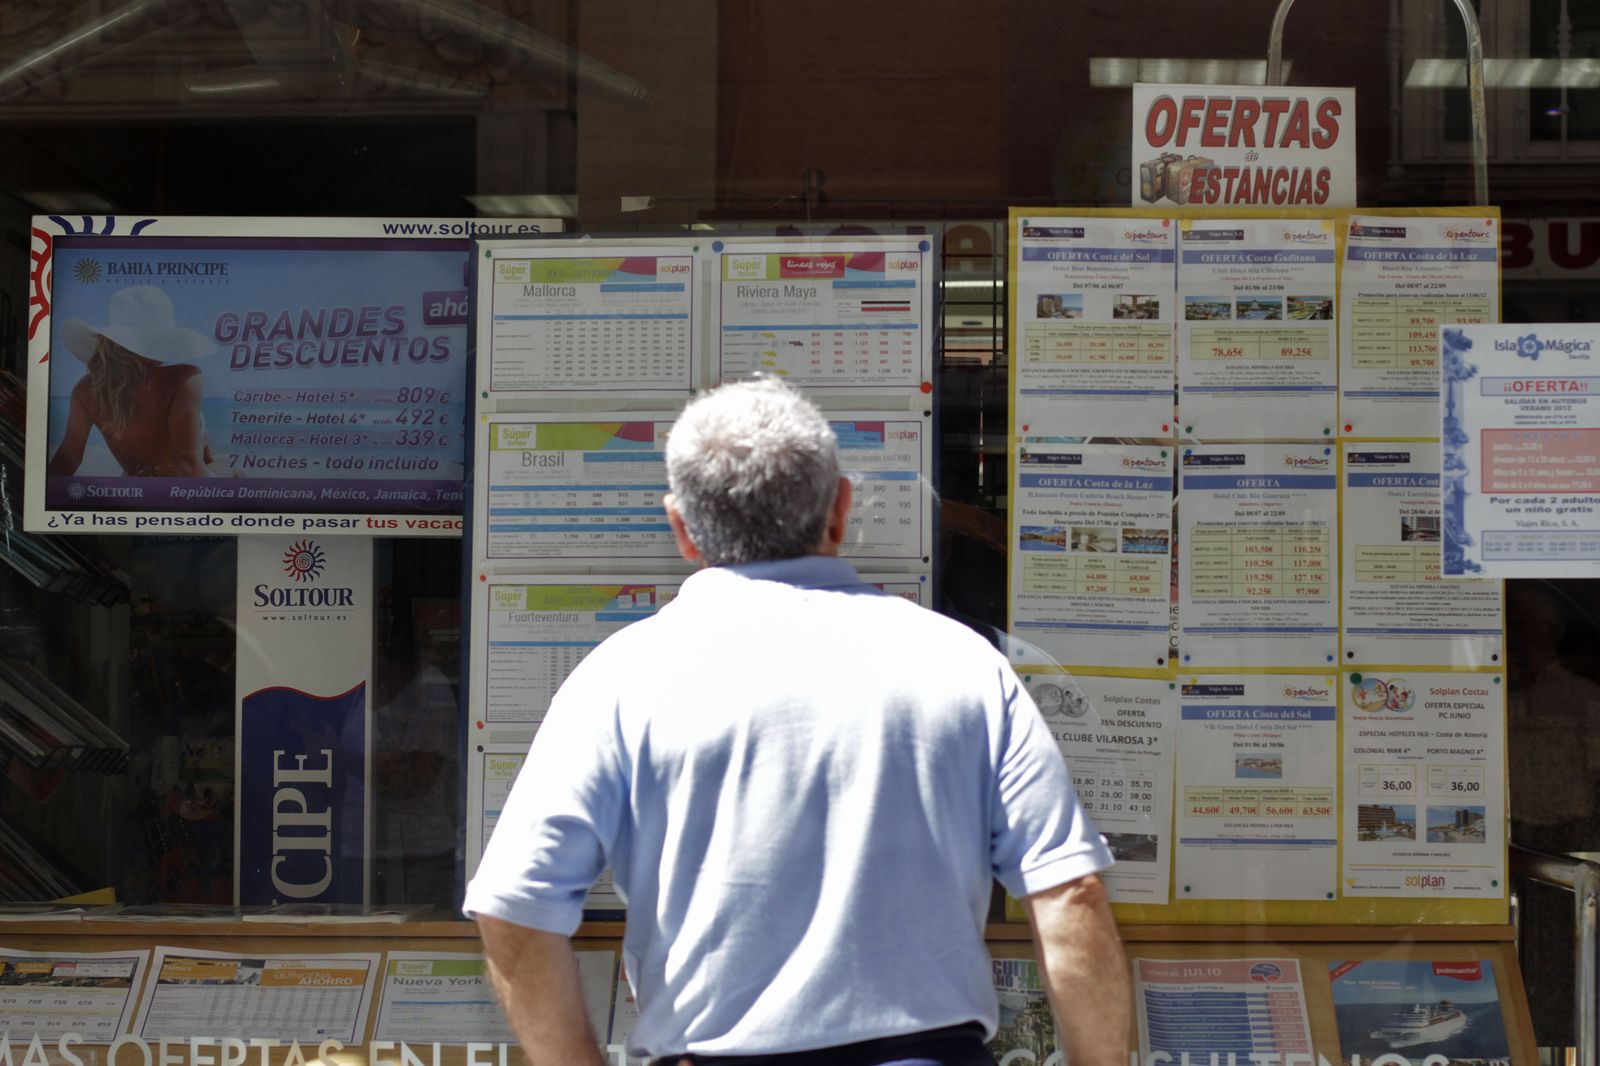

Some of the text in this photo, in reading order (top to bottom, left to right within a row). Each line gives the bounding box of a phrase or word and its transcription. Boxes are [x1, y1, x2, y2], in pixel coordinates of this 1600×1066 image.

[1145, 94, 1342, 149] OFERTAS
[1244, 150, 1259, 162] de
[1188, 166, 1332, 205] ESTANCIAS
[383, 221, 541, 235] www.soltour.es
[1047, 251, 1150, 261] OFERTA Costa del Sol
[1200, 252, 1316, 262] OFERTA Costa Gaditana
[1363, 251, 1478, 261] OFERTA Costa de la Luz
[107, 262, 229, 275] BAHIA PRINCIPE
[660, 263, 690, 274] solplan
[888, 259, 918, 270] solplan
[523, 285, 577, 297] Mallorca
[736, 285, 817, 300] Riviera Maya
[214, 305, 407, 343] GRANDES
[1494, 339, 1590, 353] Isla Mágica
[229, 336, 451, 371] DESCUENTOS
[234, 390, 281, 403] Caribe
[296, 390, 335, 403] Hotel
[397, 387, 436, 404] 809
[439, 392, 450, 404] €
[231, 411, 292, 424] Tenerife
[306, 412, 345, 424] Hotel
[395, 408, 435, 425] 492
[439, 413, 449, 425] €
[230, 433, 294, 445] Mallorca
[309, 433, 348, 446] Hotel
[395, 429, 435, 446] 339
[438, 434, 448, 446] €
[229, 454, 439, 470] 7 Noches todo incluido
[522, 451, 565, 467] Brasil
[1038, 478, 1153, 489] OFERTA Costa de la Luz
[1236, 479, 1280, 488] OFERTA
[1372, 477, 1416, 486] OFERTA
[87, 485, 144, 498] SOLTOUR
[170, 486, 234, 500] República
[238, 487, 317, 500] Dominicana,
[321, 487, 370, 501] México,
[373, 488, 431, 501] Jamaica,
[1556, 506, 1593, 514] gratis
[48, 513, 85, 528] ¿Ya
[92, 514, 128, 526] has
[135, 514, 224, 528] pensado
[231, 514, 295, 527] donde
[302, 518, 360, 530] pasar
[366, 517, 398, 529] tus
[253, 584, 355, 607] SOLTOUR
[262, 613, 347, 621] www.soltour.es
[508, 612, 579, 623] Fuerteventura
[1429, 688, 1489, 696] Solplan Costas
[1103, 694, 1161, 705] Solplan Costas
[1117, 709, 1145, 718] OFERTA
[1206, 709, 1312, 718] OFERTA Costa del Sol
[1438, 712, 1471, 720] PC JUNIO
[1117, 720, 1162, 729] DESCUENTO
[1063, 732, 1094, 743] CLUBE
[1096, 734, 1144, 745] VILAROSA
[1383, 780, 1412, 791] 36,00
[1451, 782, 1480, 792] 36,00
[271, 749, 333, 904] CIPE
[1405, 874, 1445, 889] solplan
[1182, 968, 1222, 977] JULIO
[299, 977, 353, 985] AHORRO
[393, 976, 483, 986] Nueva York
[107, 1033, 343, 1066] OFERTAS
